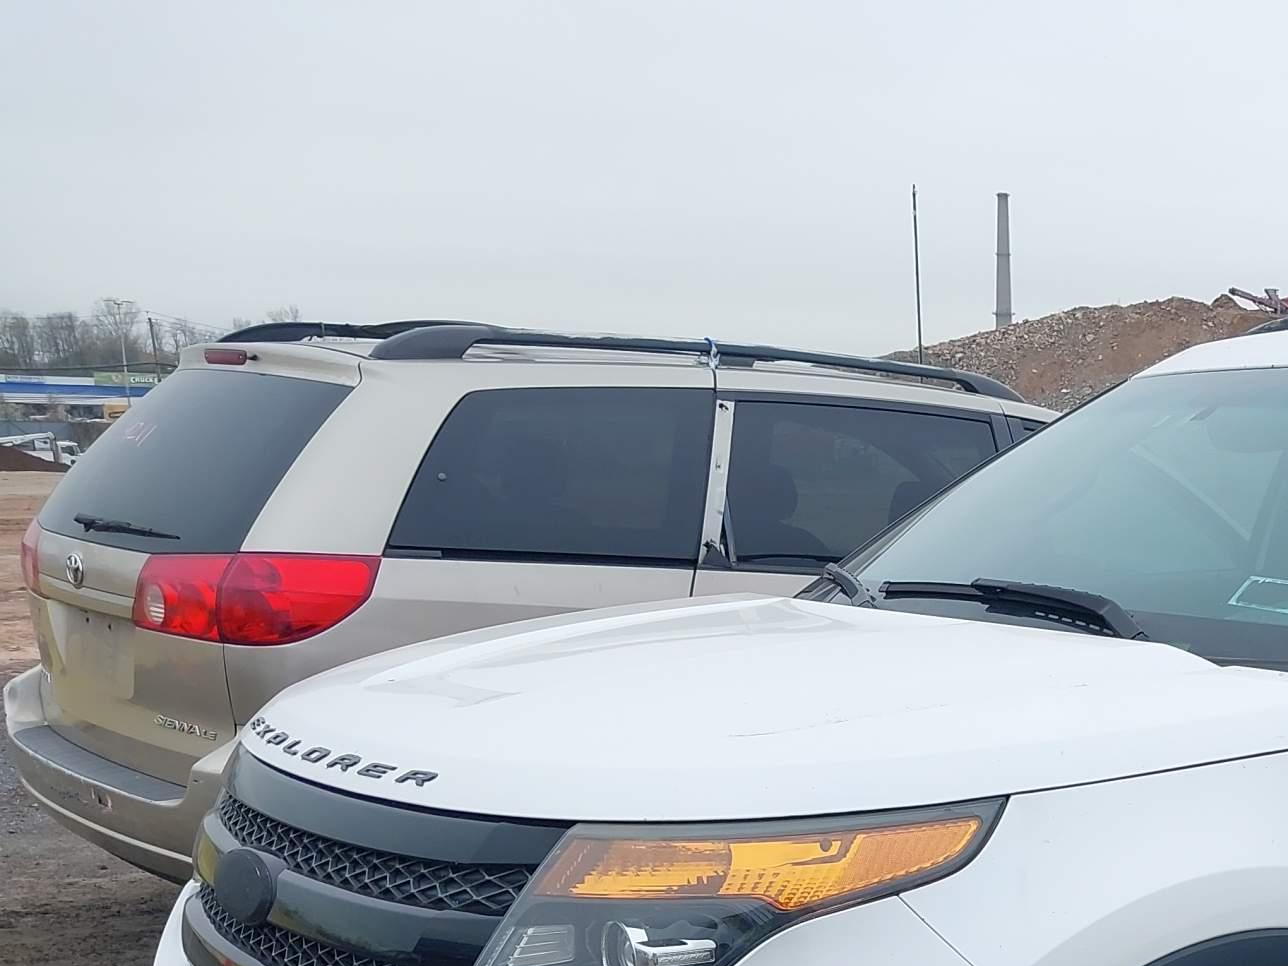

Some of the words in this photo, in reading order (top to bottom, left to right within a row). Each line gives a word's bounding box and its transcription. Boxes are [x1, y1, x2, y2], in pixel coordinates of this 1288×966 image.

[154, 714, 200, 737] SIENNA
[202, 729, 217, 741] LE
[250, 716, 438, 787] EXPLORER
